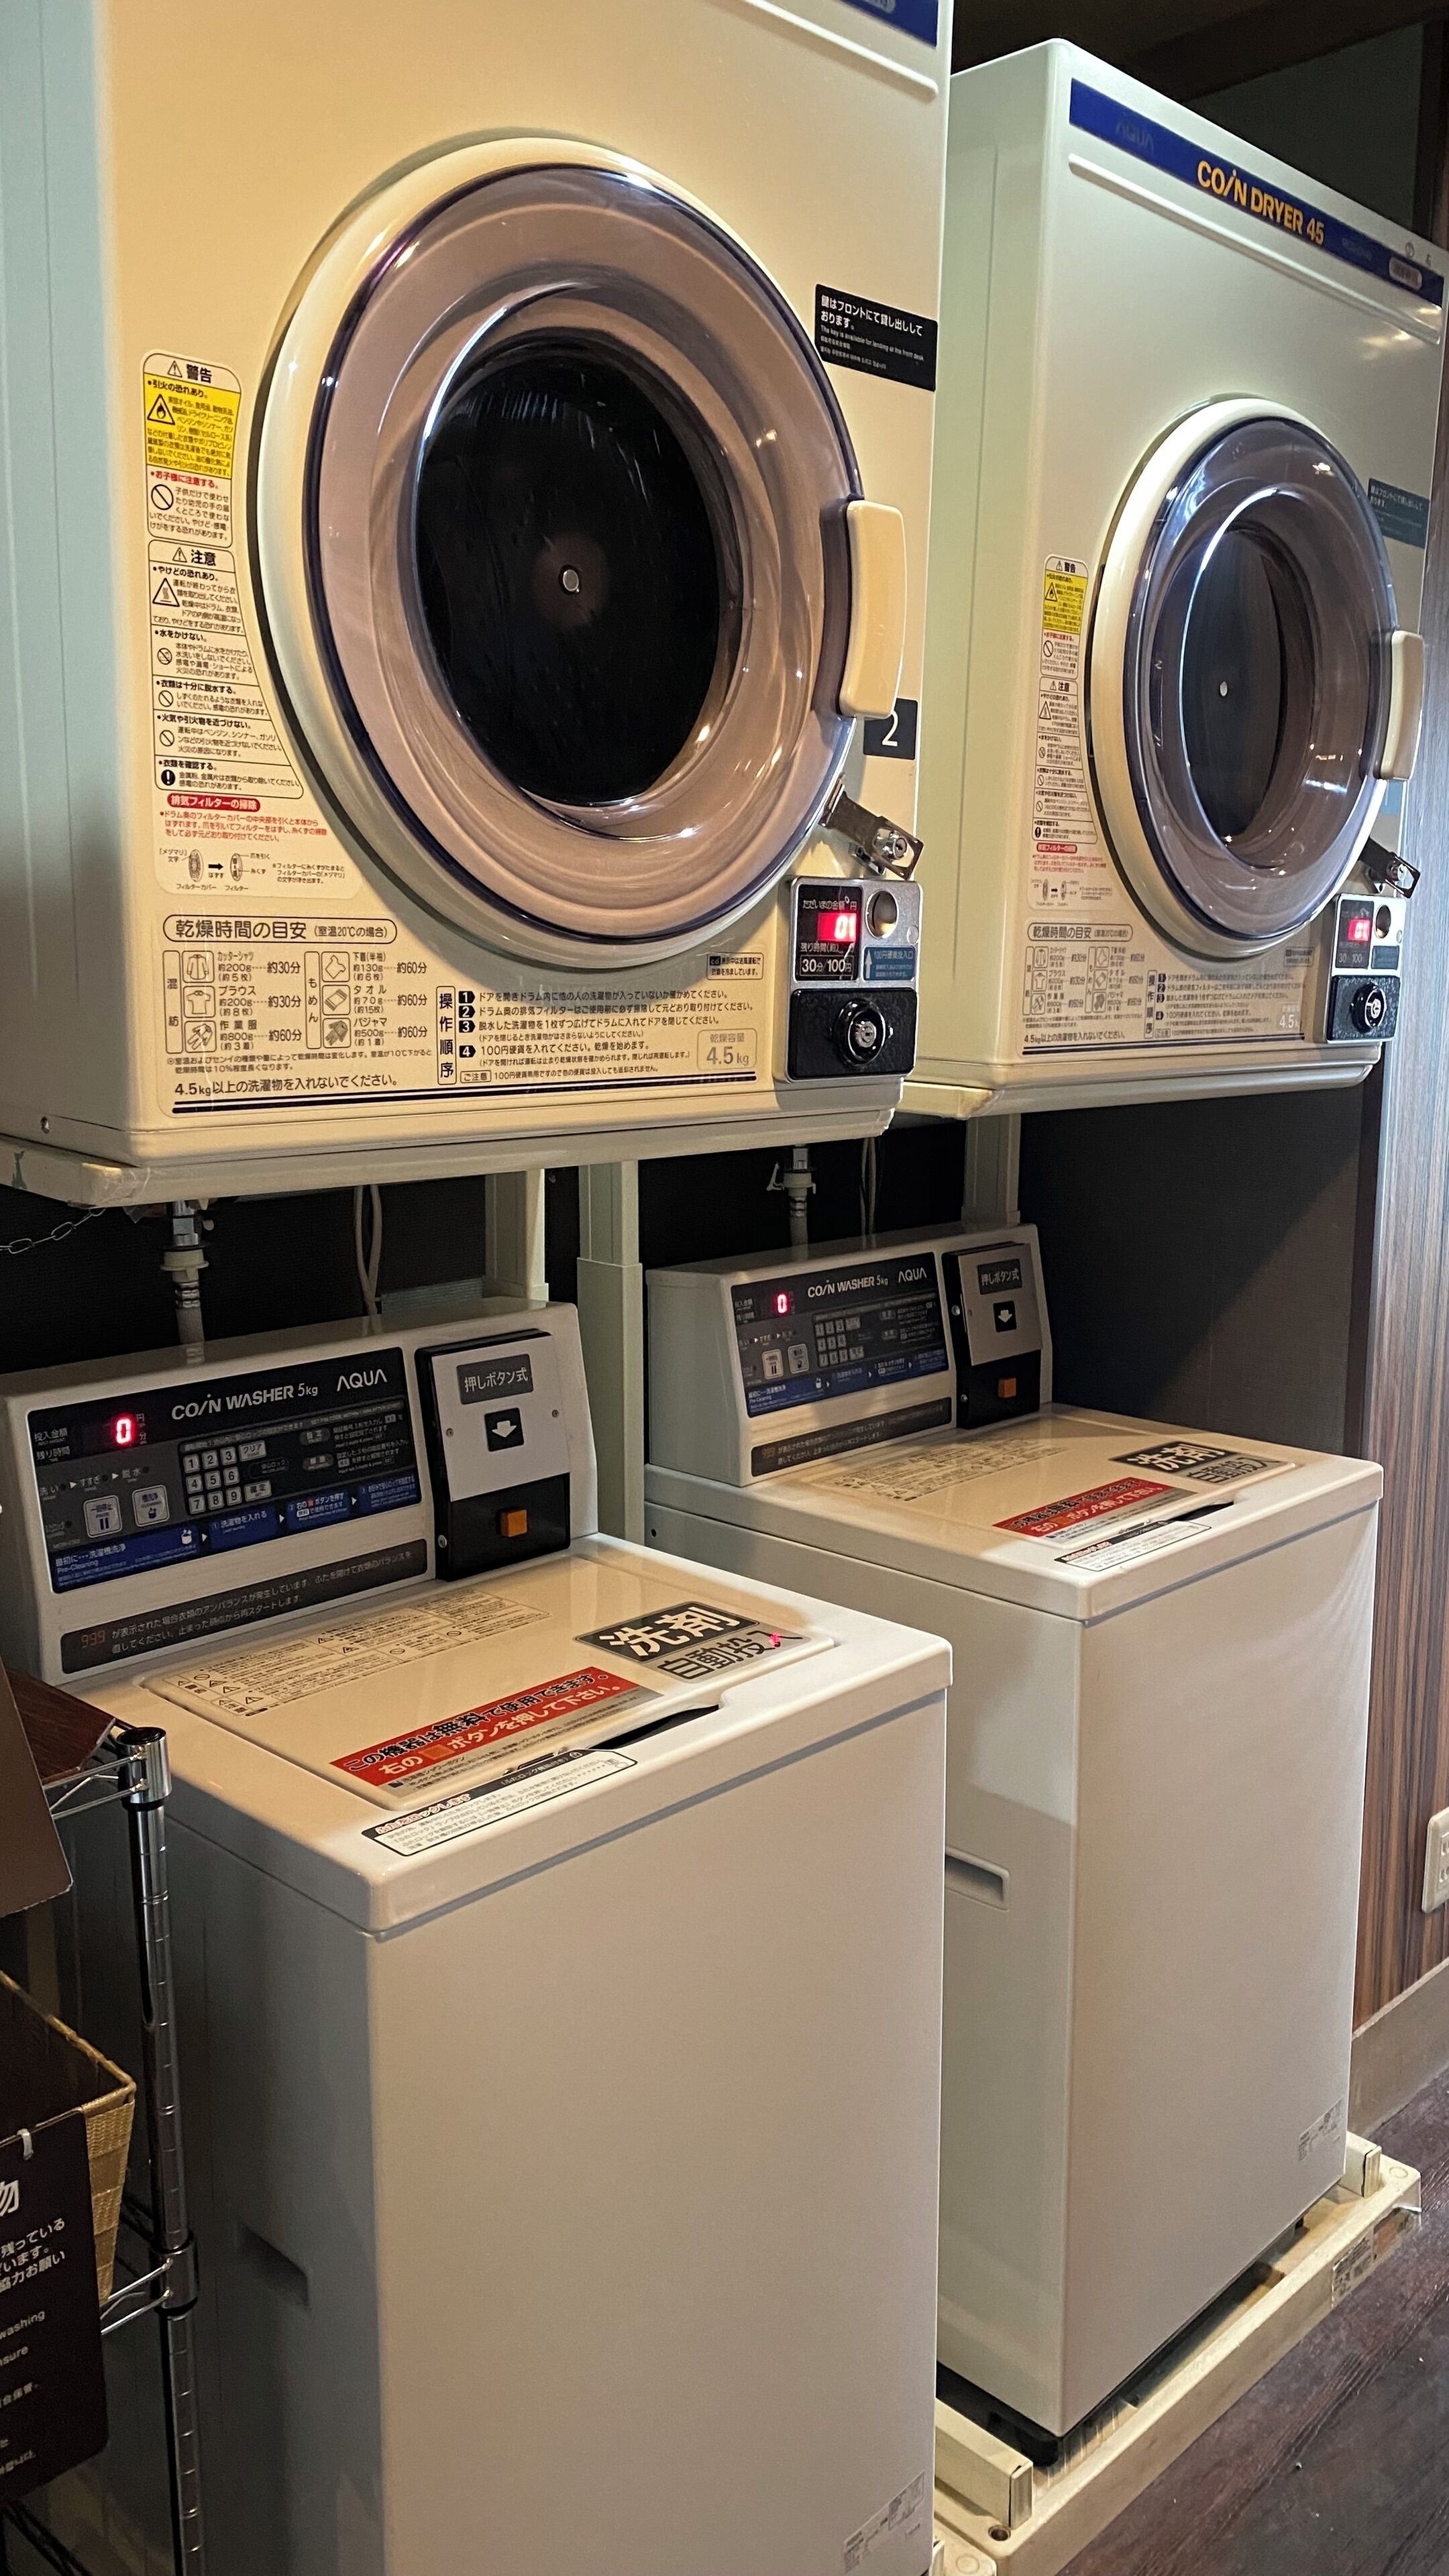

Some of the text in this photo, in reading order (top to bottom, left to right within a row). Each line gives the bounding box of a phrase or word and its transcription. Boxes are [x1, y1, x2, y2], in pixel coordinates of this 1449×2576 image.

[1251, 186, 1303, 235] DRYER
[1307, 217, 1325, 246] 45
[821, 310, 855, 330] おります。
[186, 364, 212, 383] 警告
[153, 378, 208, 399] 引火の恐れあり。
[156, 471, 218, 489] お子様に注意する。
[175, 486, 229, 502] 子供だけで使わせ
[176, 507, 229, 521] くところで使わな
[150, 521, 227, 541] けがをする恐れがあります。
[191, 549, 216, 566] 注意
[158, 566, 219, 582] やけどの恐れあり。
[173, 579, 236, 594] 運転が終わってから衣
[160, 629, 207, 642] 水をかけない。
[161, 680, 236, 695] 衣類は十分に脱水する。
[1058, 681, 1070, 692] 注意
[162, 713, 251, 729] 火気や引火物を近づけない。
[882, 710, 899, 747] 2
[162, 759, 217, 771] 衣類を確認する。
[179, 780, 241, 790] 感電の恐れがあります。
[171, 795, 258, 810] 排気フィルターの掃除
[176, 919, 307, 939] 乾燥時間の目安
[1033, 926, 1092, 939] 乾燥時間の目安
[218, 961, 301, 973] 約200g 約30分
[353, 962, 427, 974] 約130g 約60分
[219, 985, 256, 996] ブラウス
[354, 985, 387, 994] タオル
[463, 991, 468, 1002] 1
[219, 996, 301, 1008] 約200g 約30分
[308, 977, 319, 1023] もめん
[397, 994, 427, 1006] 約60分
[462, 1007, 470, 1017] 2
[220, 1020, 257, 1030] 作業服
[354, 1026, 428, 1038] 約500g 約60分
[462, 1022, 470, 1032] 3
[220, 1030, 302, 1042] 約800g 約60分
[439, 993, 453, 1079] 操作順序
[710, 1032, 745, 1043] 乾燥容量
[462, 1040, 649, 1057] 4 100円硬貨を入れてください。乾燥を始めます。
[464, 1071, 488, 1081] ご注意
[174, 1075, 398, 1097] 4.5kg以上の洗濯物を入れないでください。
[837, 1276, 875, 1293] WASHER
[876, 1275, 889, 1286] 5kg
[898, 1267, 927, 1283] AQUA
[981, 1267, 1020, 1287] 押しボタン式
[777, 1293, 788, 1313] 0
[464, 1366, 529, 1393] 押しボタン式
[226, 1384, 294, 1410] WASHER
[297, 1383, 319, 1397] 5kg
[337, 1368, 388, 1392] AQUA
[34, 1427, 68, 1442] 投入金額
[115, 1418, 132, 1444] 0
[36, 1446, 70, 1460] 残り時間
[244, 1444, 262, 1454] クリア
[1127, 1443, 1226, 1471] 洗剤
[189, 1451, 232, 1468] 1 2 3
[1186, 1457, 1281, 1484] 自動投入
[80, 1475, 101, 1487] すすぎ
[192, 1471, 235, 1489] 4 5 6
[194, 1491, 237, 1509] 7 8 9
[220, 1511, 267, 1529] 洗濯物を入れる
[1031, 1520, 1059, 1533] 右の
[599, 1606, 741, 1657] 洗剤
[657, 1630, 804, 1679] 自動投入
[345, 1673, 609, 1772] この機器は無料で使用できます。
[379, 1755, 423, 1776] 右の
[447, 1684, 621, 1750] ボタンを押して下さい。
